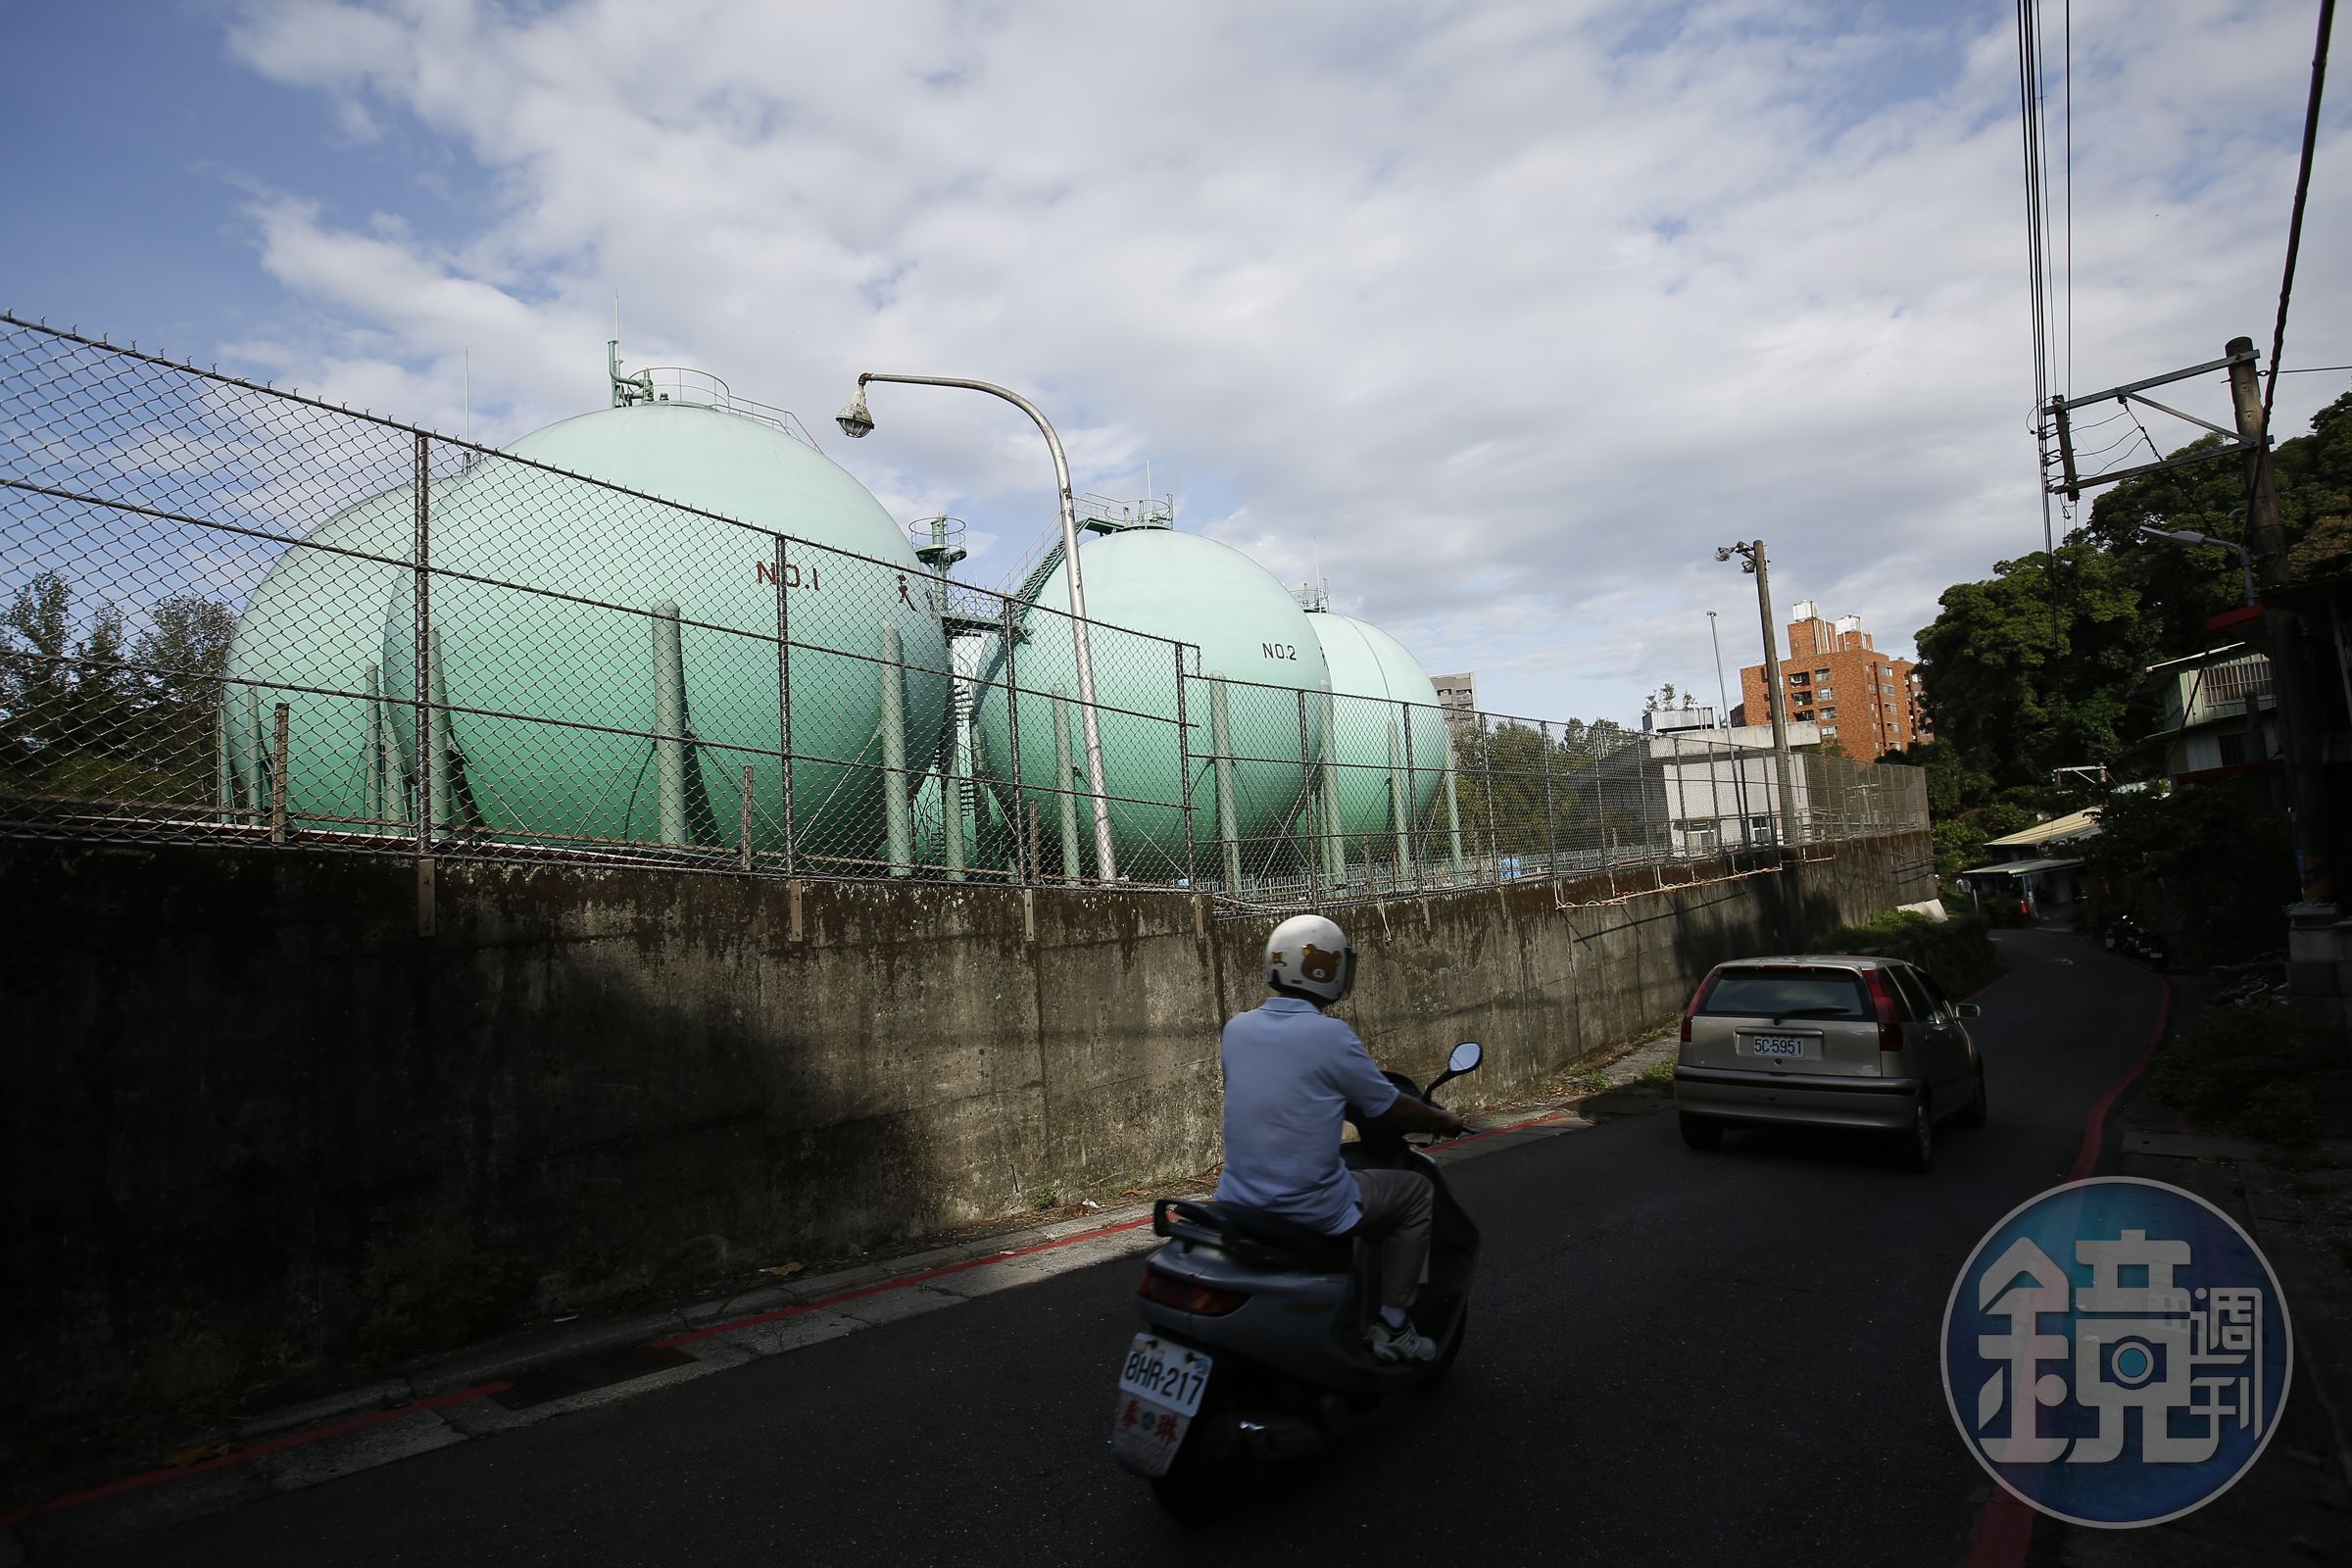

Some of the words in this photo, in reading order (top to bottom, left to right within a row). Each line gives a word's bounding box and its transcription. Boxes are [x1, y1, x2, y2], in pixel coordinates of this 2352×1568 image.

[757, 561, 820, 591] NO.1
[1262, 642, 1297, 662] NO.2
[1754, 1039, 1801, 1054] 5C-5951
